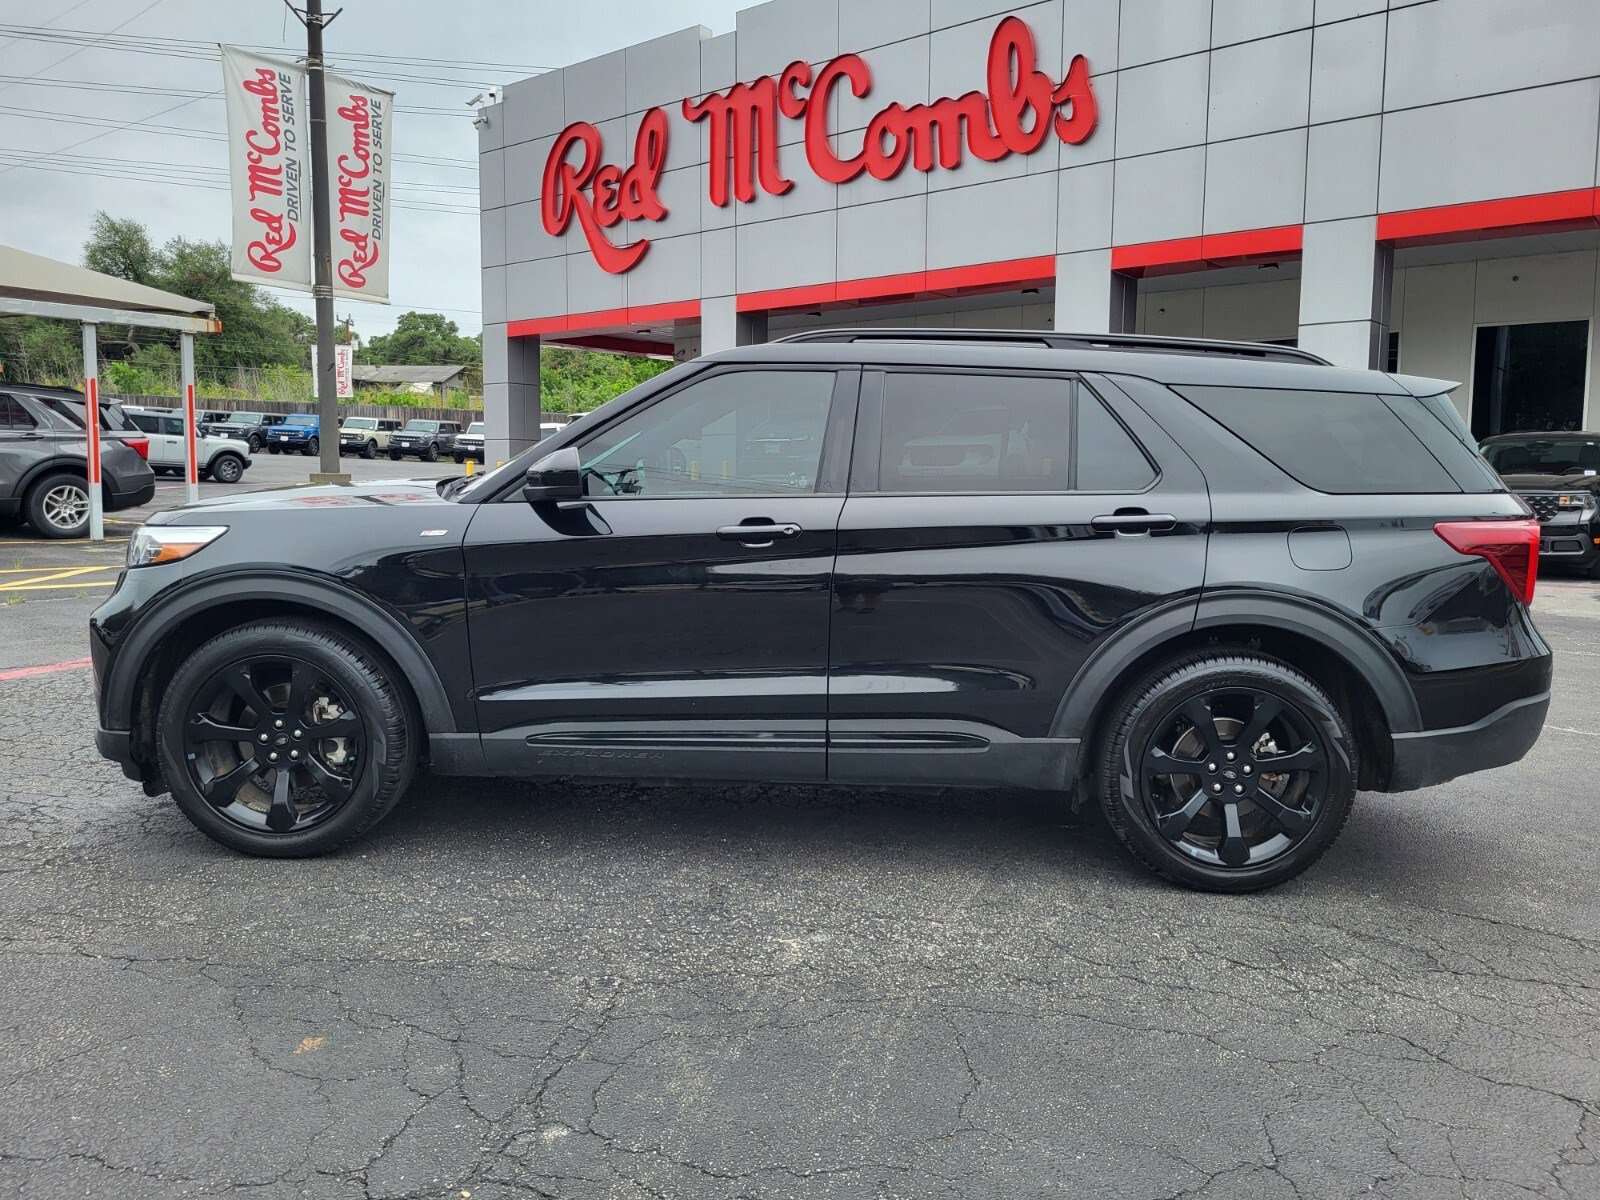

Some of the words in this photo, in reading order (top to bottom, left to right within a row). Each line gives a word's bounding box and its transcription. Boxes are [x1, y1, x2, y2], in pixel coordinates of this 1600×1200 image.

[278, 72, 296, 126] SERVE
[370, 98, 382, 150] SERVE
[283, 128, 297, 152] TO
[372, 151, 383, 175] TO
[284, 157, 299, 223] DRIVEN
[371, 180, 383, 241] DRIVEN
[541, 106, 668, 274] Red
[247, 207, 297, 273] Red
[337, 228, 379, 288] Red
